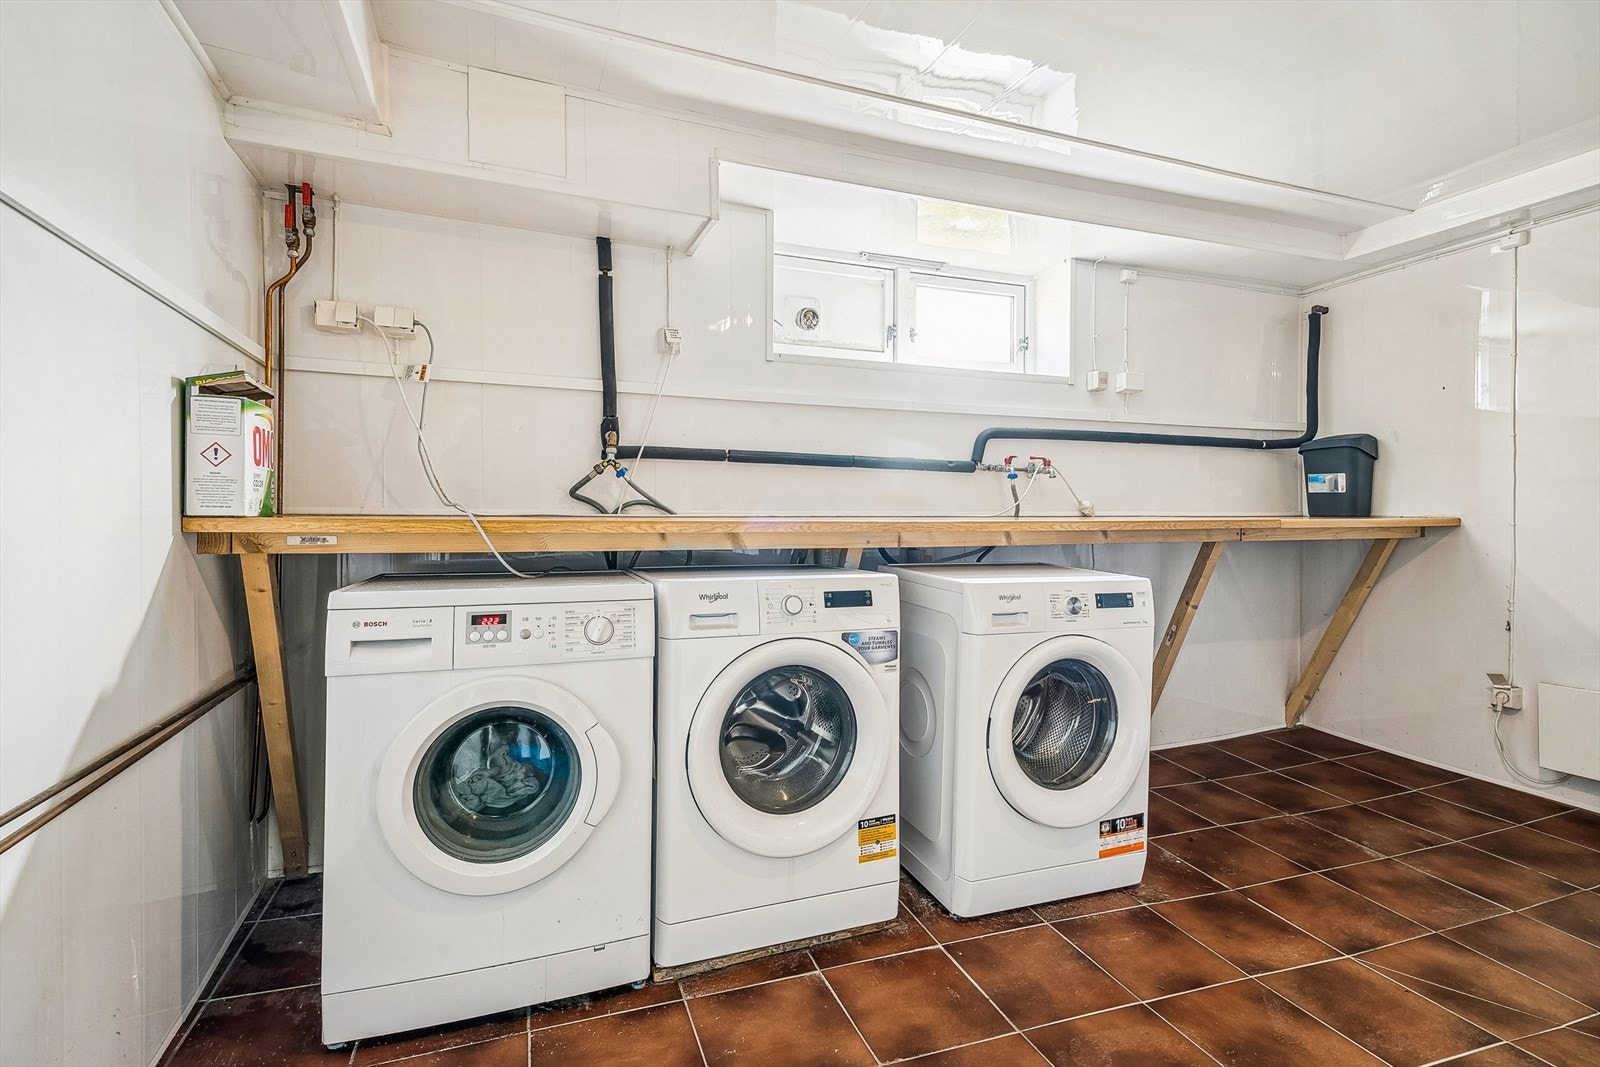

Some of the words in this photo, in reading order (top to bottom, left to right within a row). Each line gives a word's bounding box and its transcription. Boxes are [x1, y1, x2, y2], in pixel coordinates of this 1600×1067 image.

[252, 425, 275, 470] OMO
[698, 592, 729, 603] Whirlpool
[998, 592, 1022, 603] Whirlpool
[1116, 818, 1126, 830] 10
